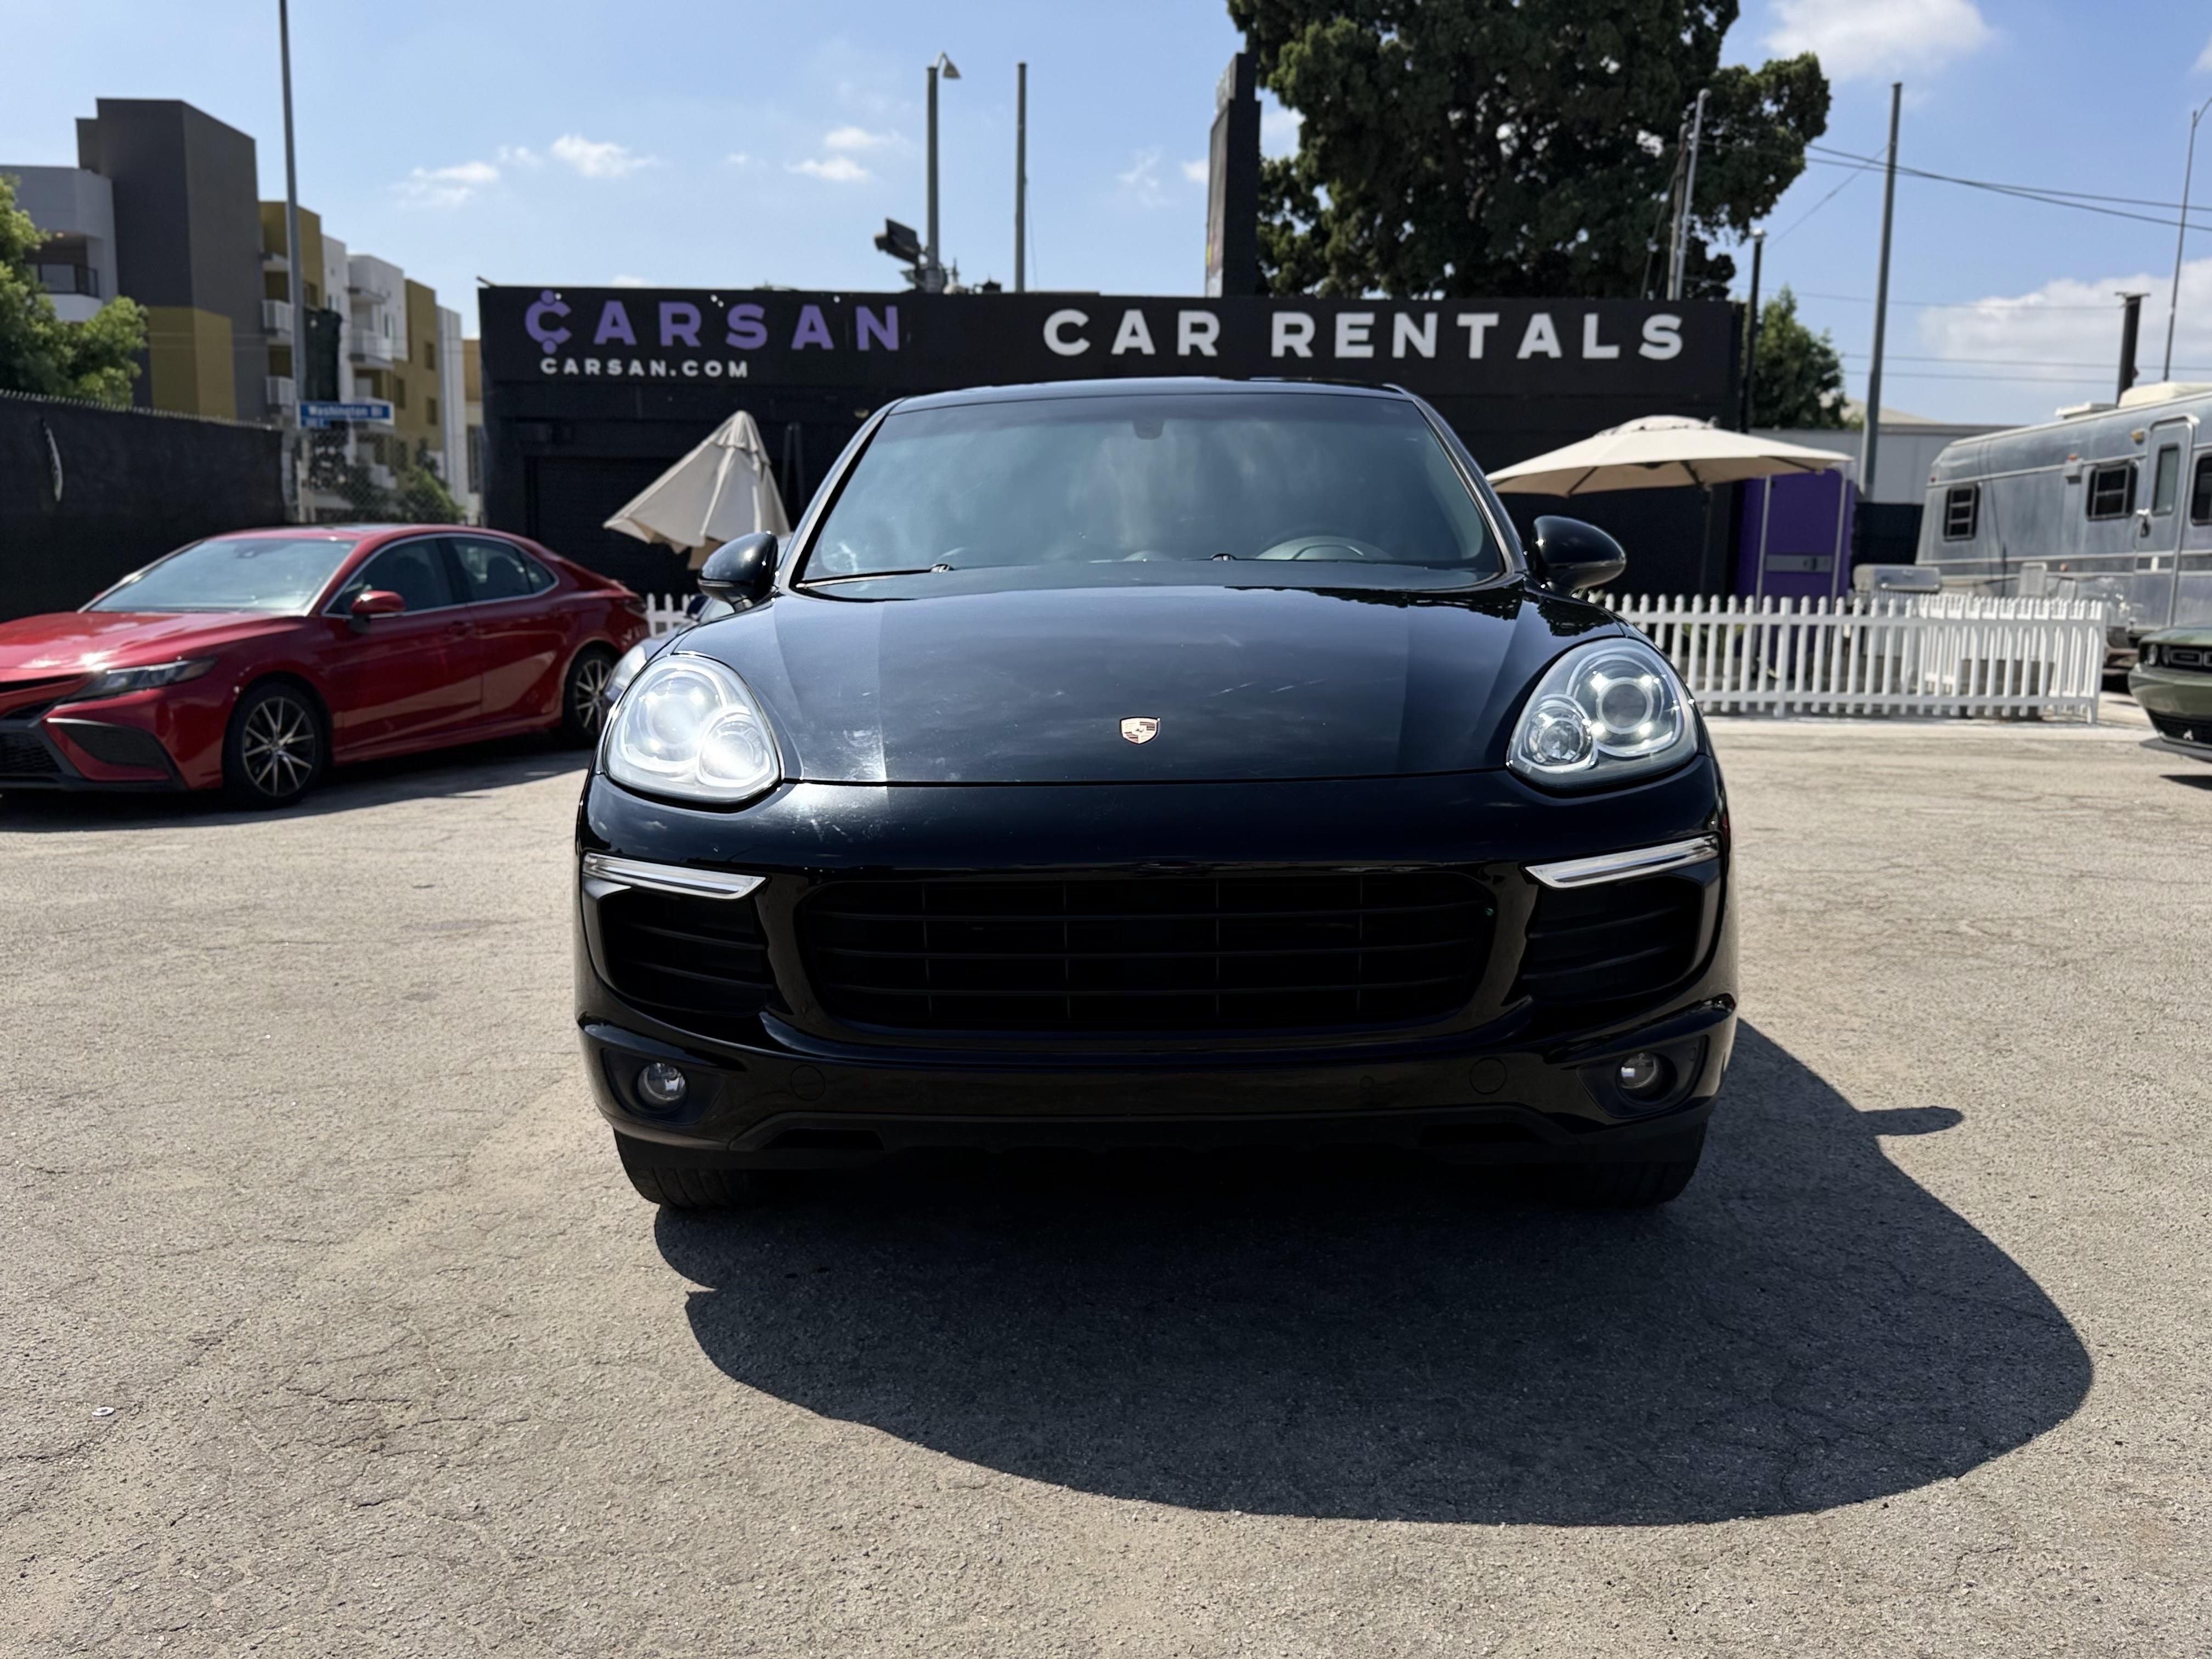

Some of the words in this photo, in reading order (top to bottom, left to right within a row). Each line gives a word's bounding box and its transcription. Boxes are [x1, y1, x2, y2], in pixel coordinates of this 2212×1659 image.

[525, 290, 899, 354] CARSAN
[1043, 309, 1221, 357] CAR
[1271, 311, 1683, 360] RENTALS
[540, 357, 748, 378] CARSAN.COM
[308, 405, 368, 418] Washington
